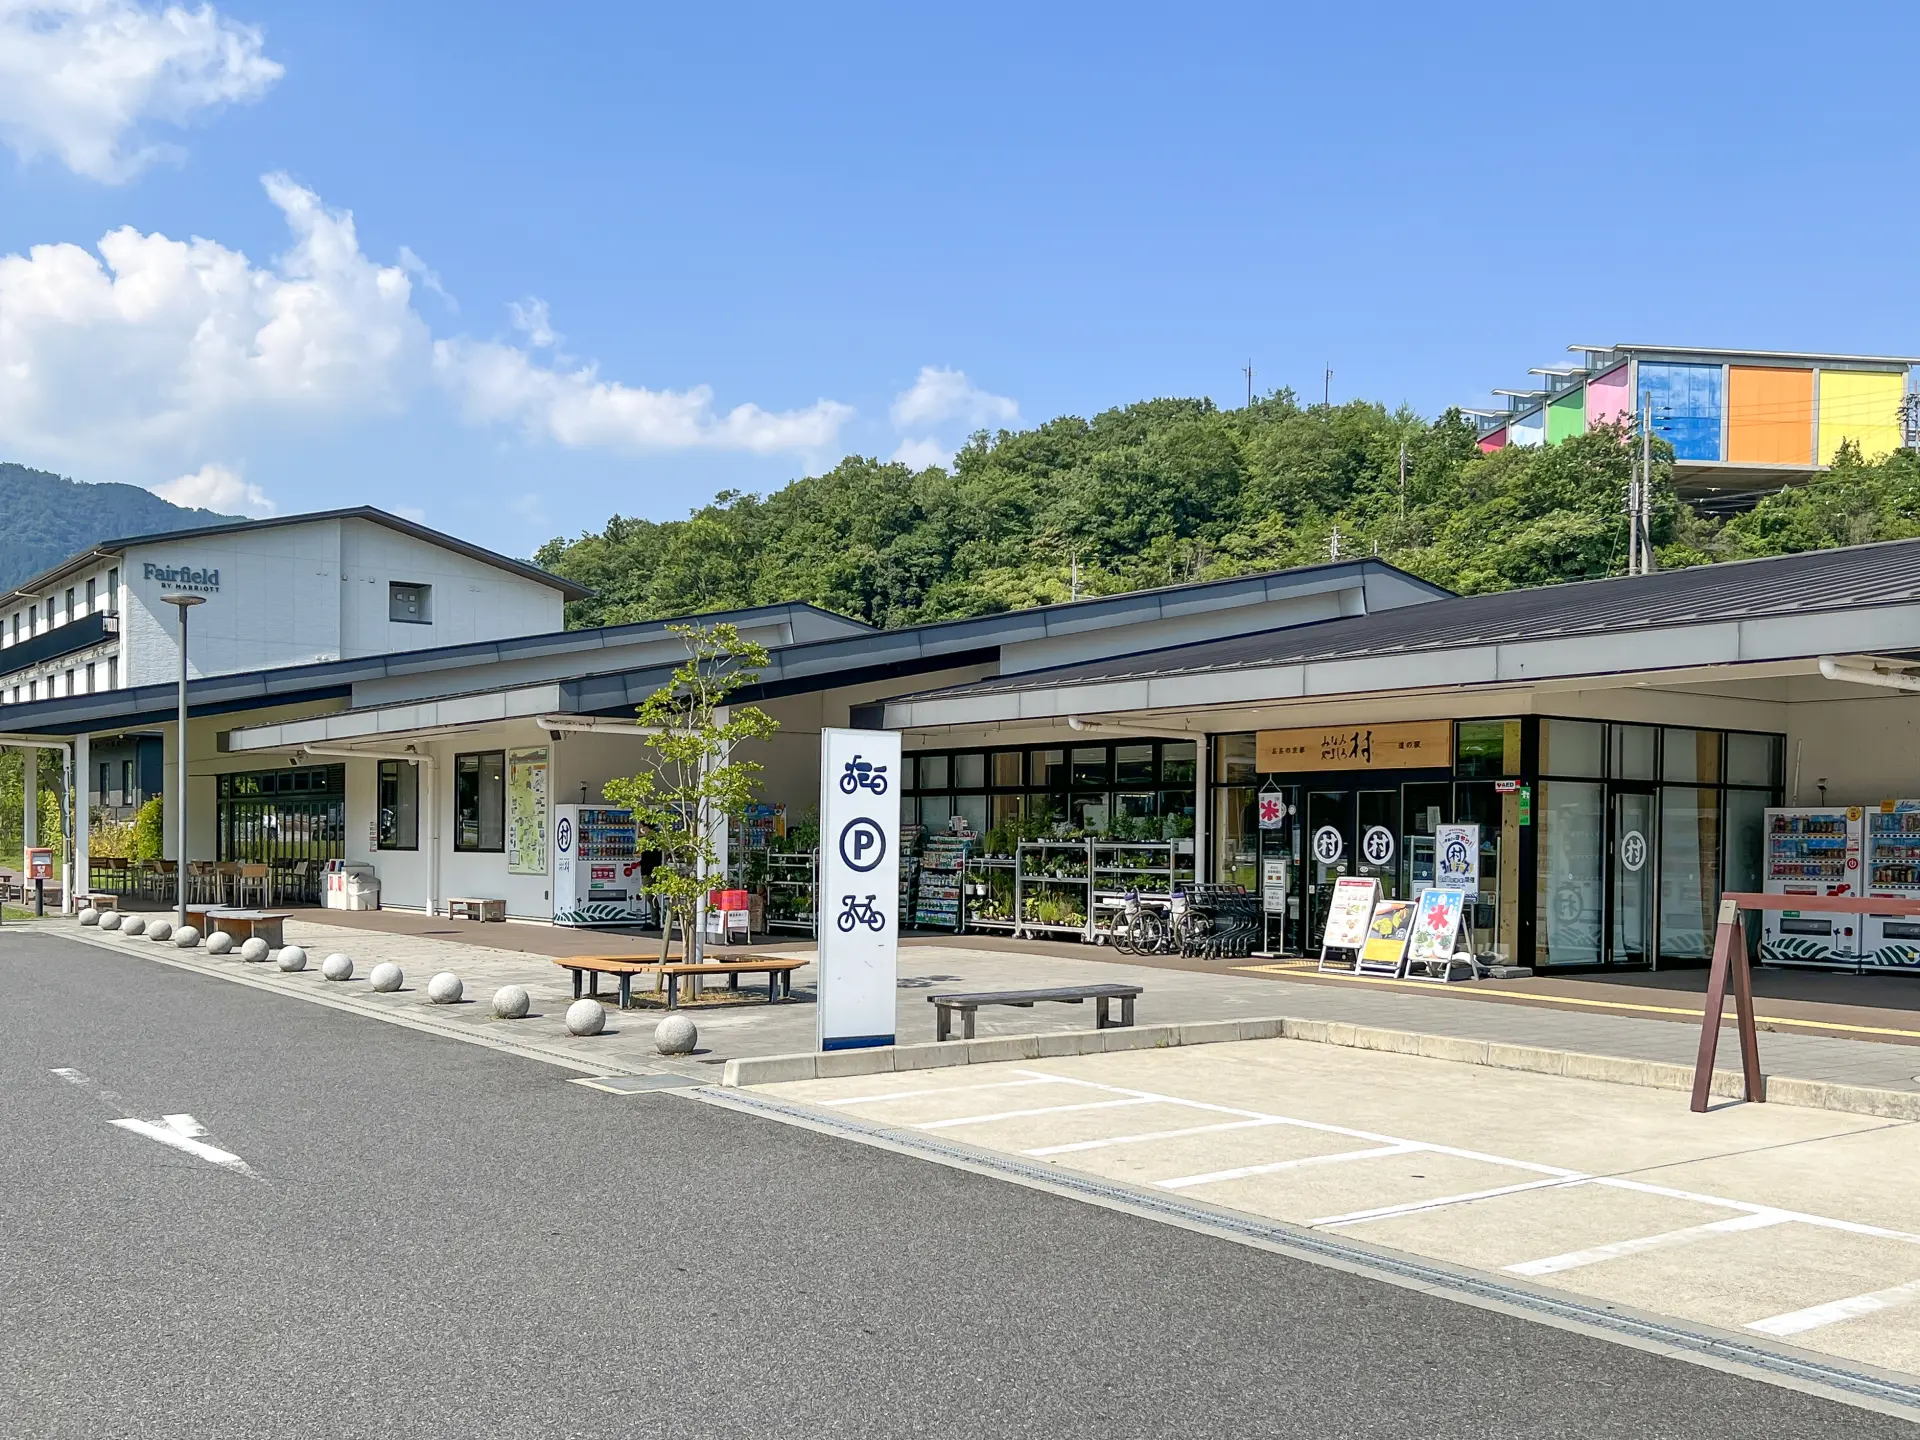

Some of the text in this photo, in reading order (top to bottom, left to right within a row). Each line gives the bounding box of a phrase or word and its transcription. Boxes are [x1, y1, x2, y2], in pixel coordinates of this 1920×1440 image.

[143, 563, 220, 585] Fairfield
[175, 584, 220, 592] MARRIOTT
[1348, 730, 1373, 763] 村
[854, 829, 874, 860] P
[1318, 833, 1338, 857] 村
[1368, 833, 1389, 858] 村
[1449, 846, 1464, 863] 村
[1625, 838, 1643, 863] 村
[1427, 904, 1449, 930] 氷
